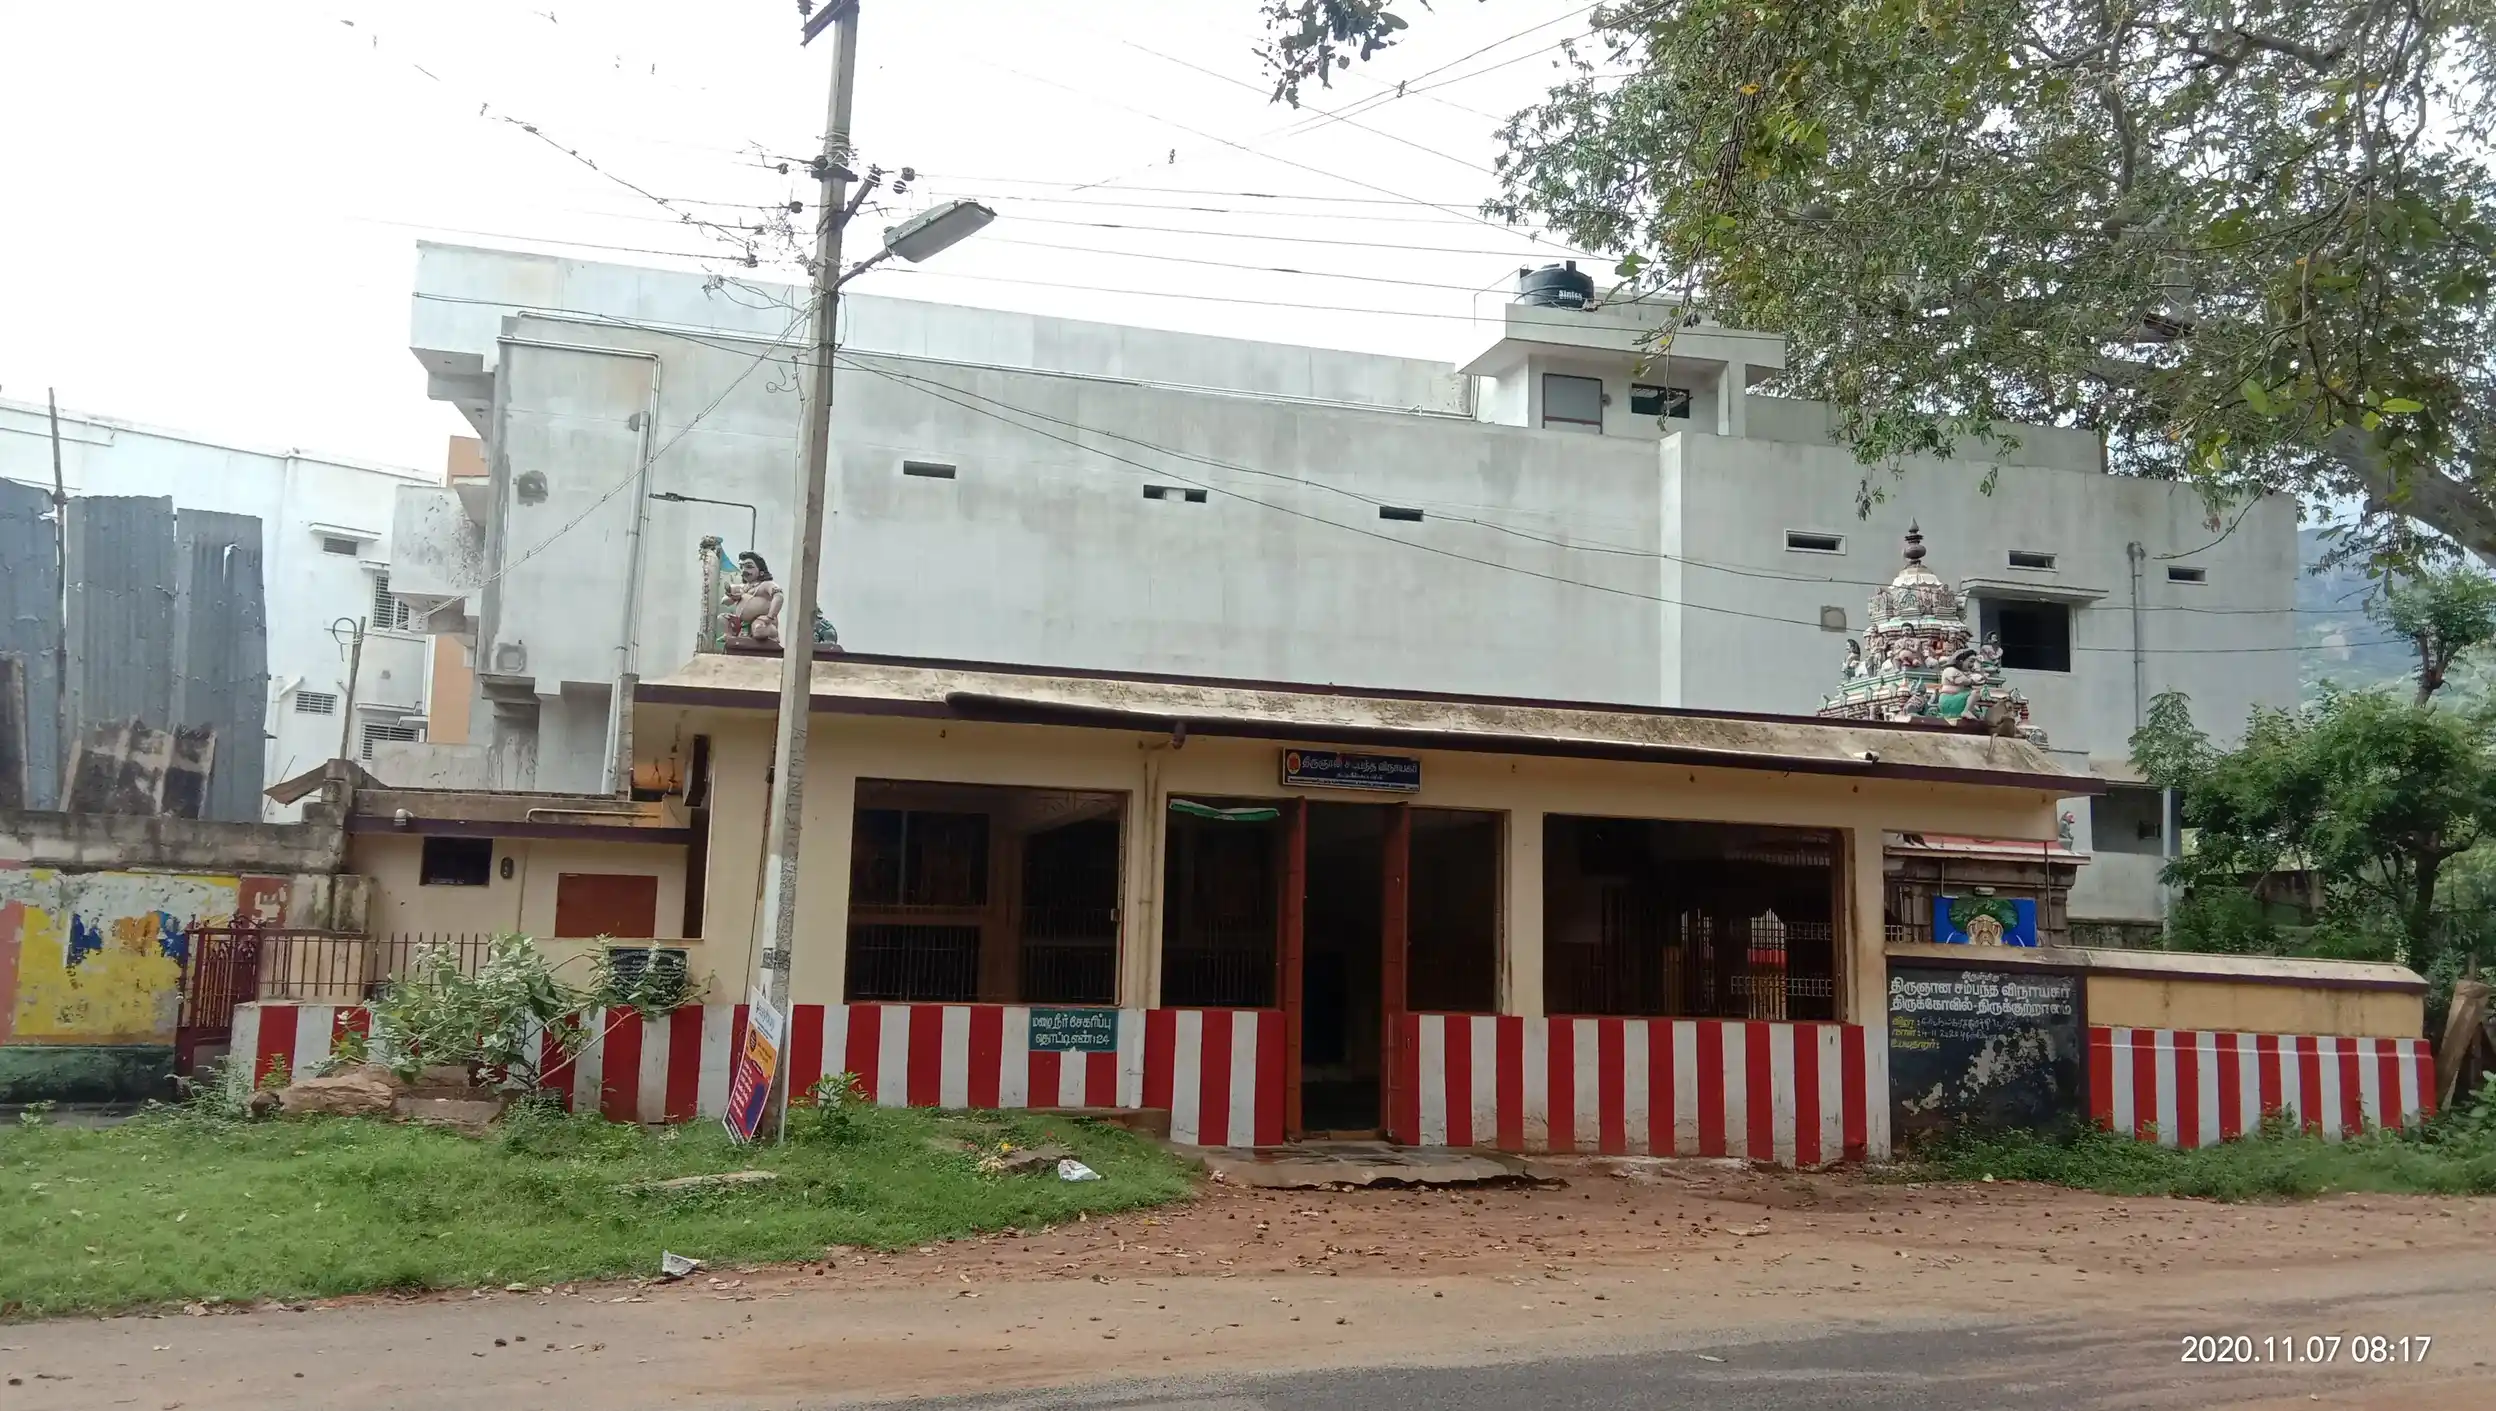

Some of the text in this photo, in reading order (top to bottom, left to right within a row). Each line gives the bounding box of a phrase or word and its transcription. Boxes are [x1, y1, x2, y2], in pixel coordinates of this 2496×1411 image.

[1889, 976, 2071, 999] திருஞான சம்பந்த விநாயகர்
